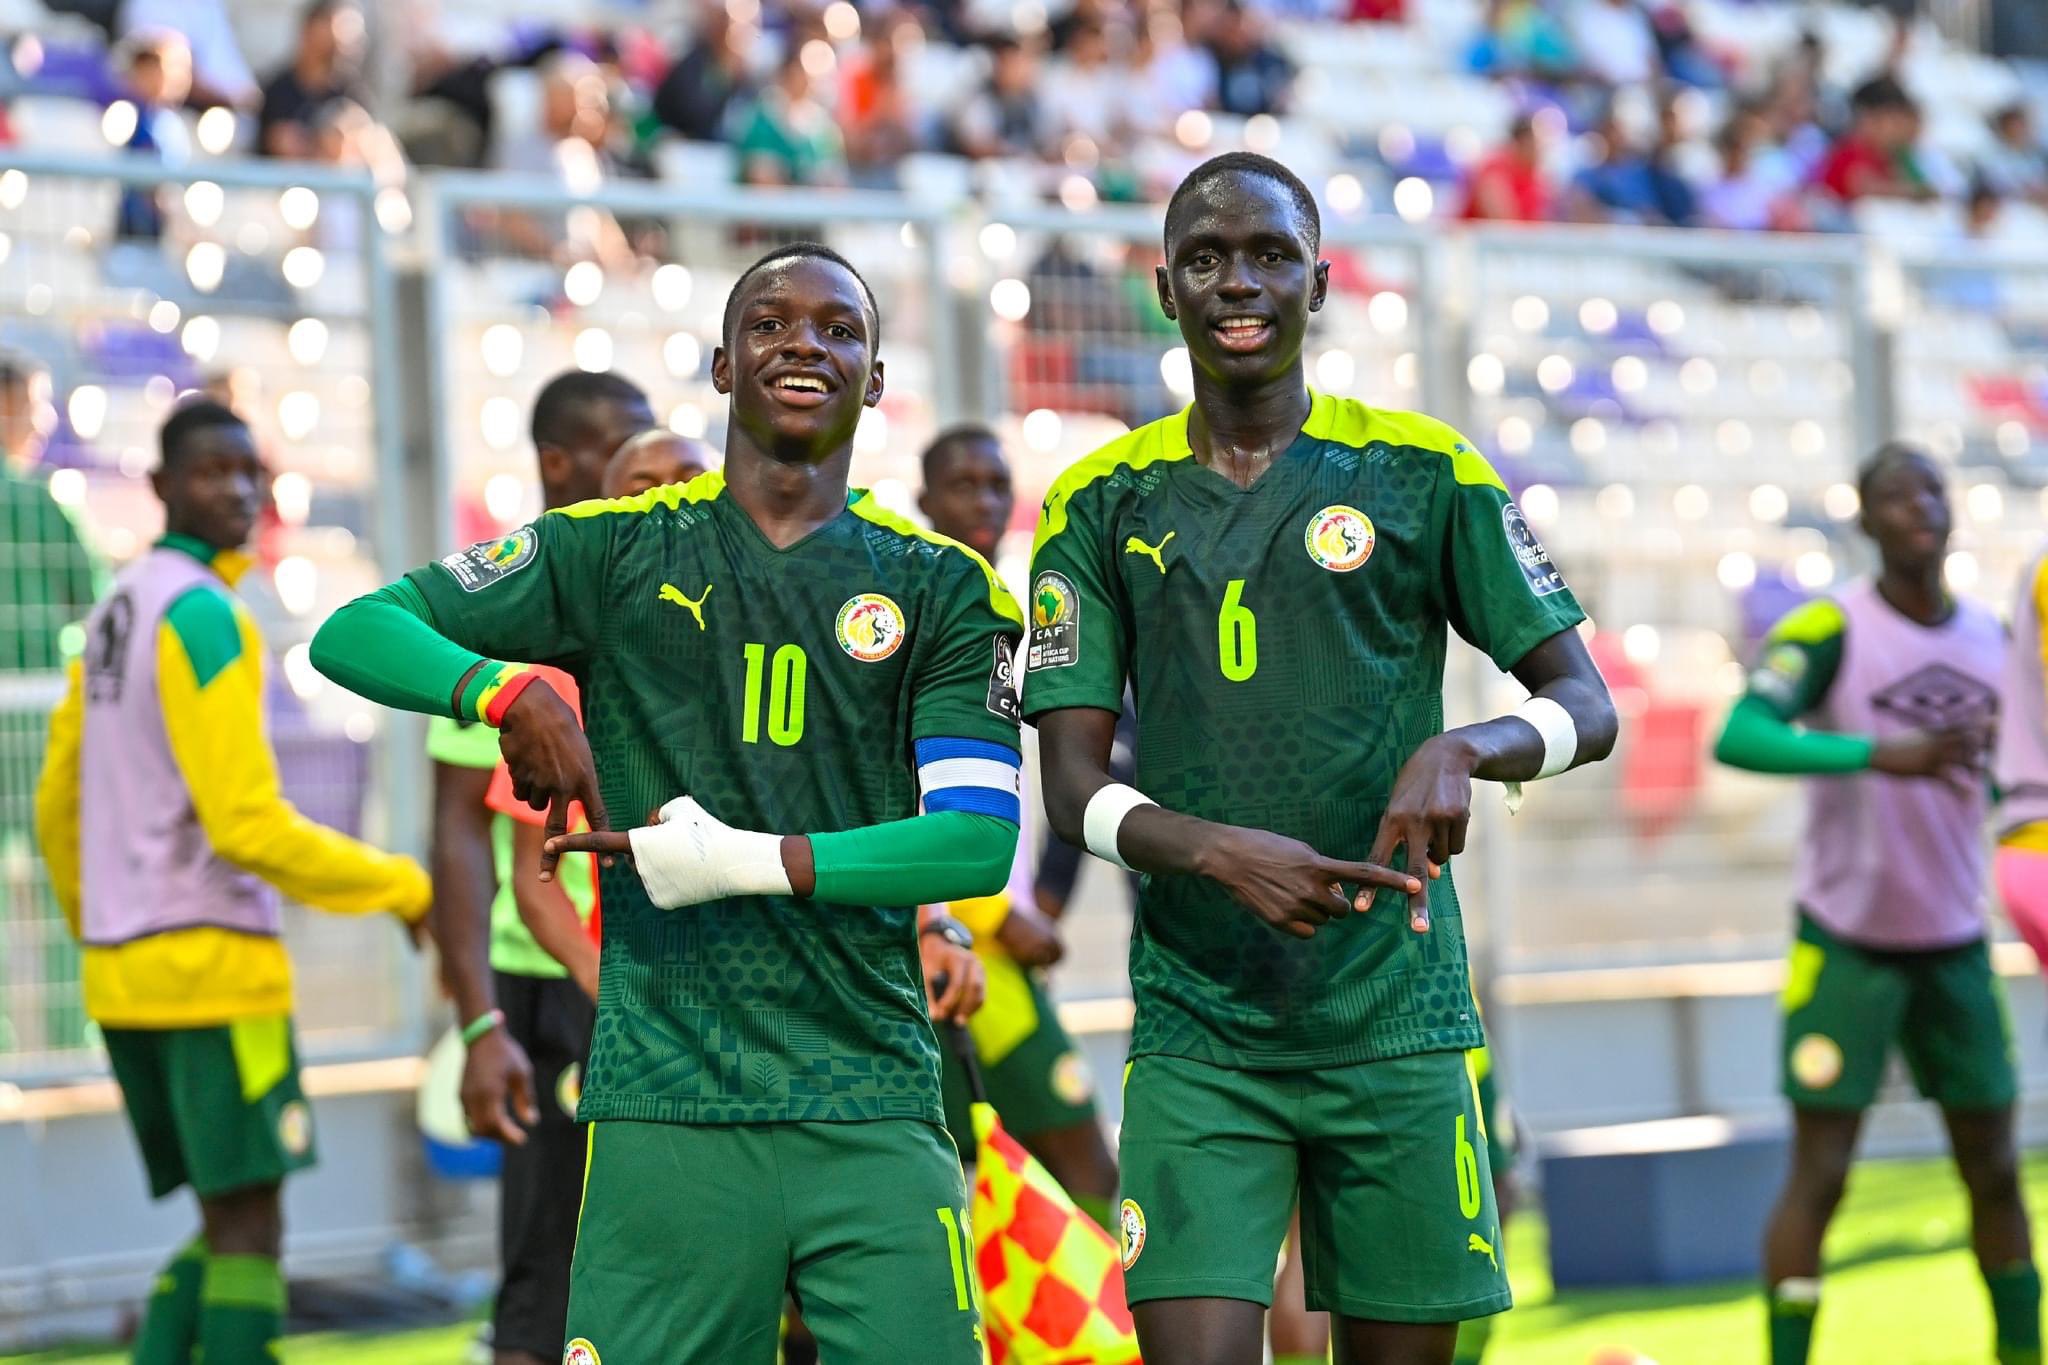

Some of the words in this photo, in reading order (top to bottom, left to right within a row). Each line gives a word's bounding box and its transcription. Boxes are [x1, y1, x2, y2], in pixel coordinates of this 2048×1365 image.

[470, 549, 495, 571] CAF
[1533, 572, 1559, 588] CAF
[1036, 626, 1063, 641] CAF
[1218, 579, 1258, 682] 6
[742, 643, 807, 747] 10
[1000, 698, 1021, 719] CA
[1455, 1113, 1480, 1220] 6
